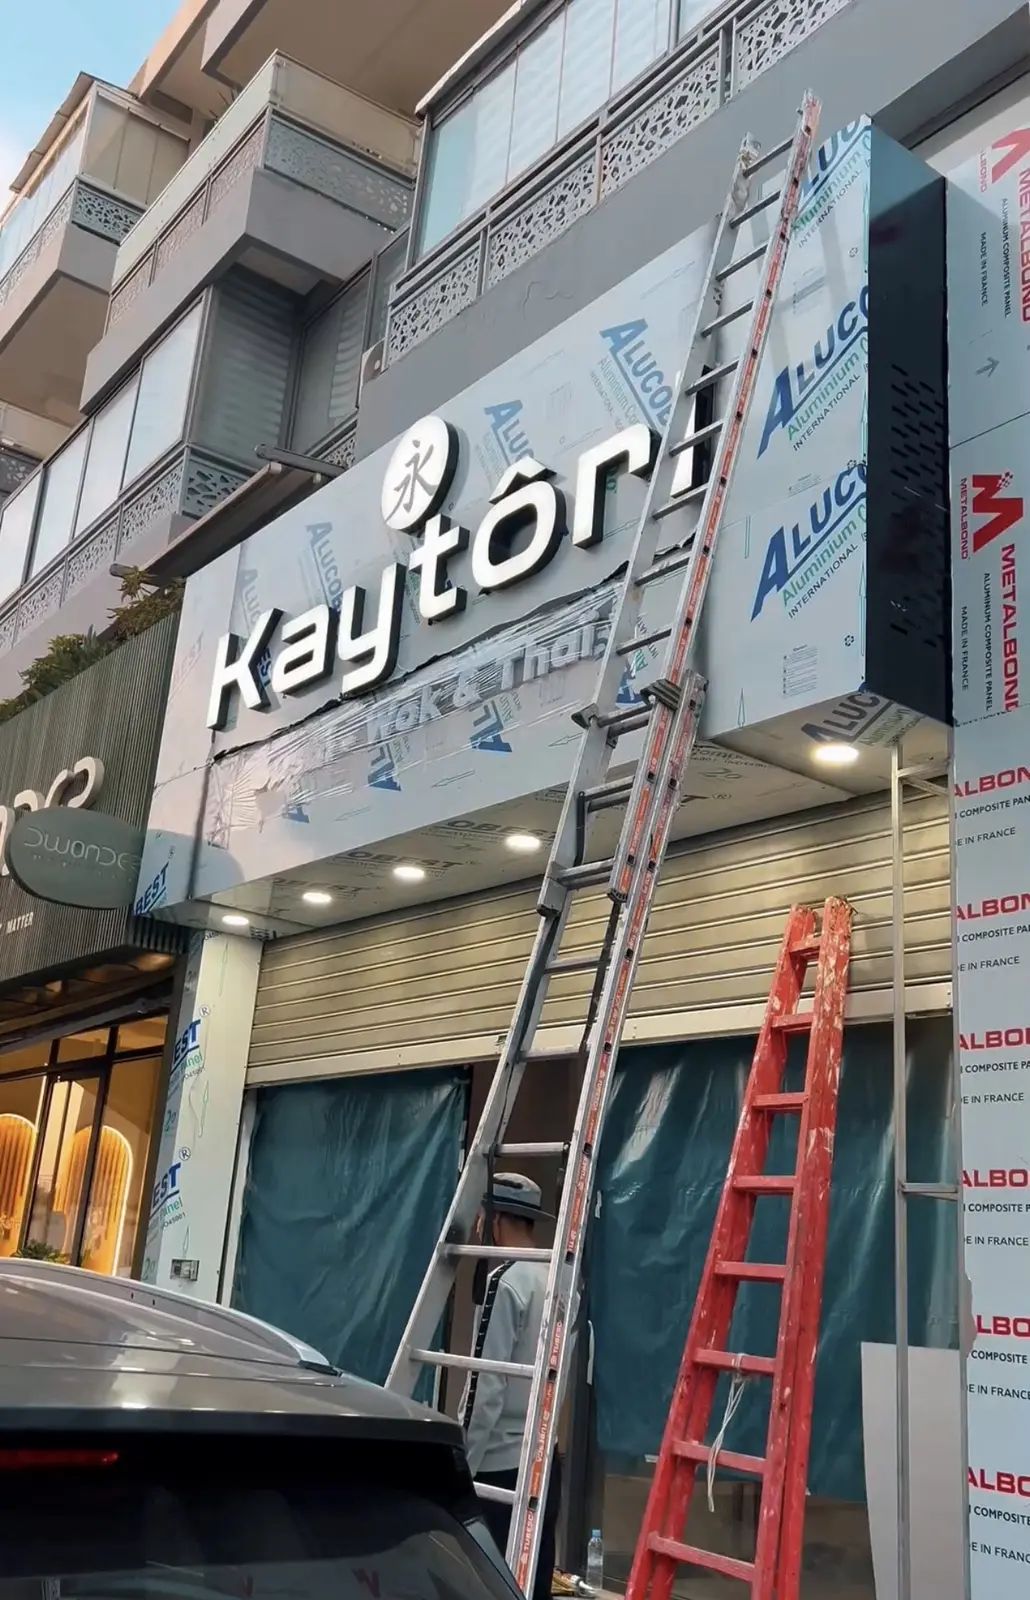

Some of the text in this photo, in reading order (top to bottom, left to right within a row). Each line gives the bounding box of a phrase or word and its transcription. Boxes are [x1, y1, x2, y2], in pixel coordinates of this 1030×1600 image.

[797, 169, 862, 248] INTERNATIONAL
[1002, 242, 1011, 290] COMPOSITE
[981, 270, 989, 307] FRANCE
[1004, 290, 1012, 319] PANEL
[787, 352, 861, 441] Aluminium
[793, 375, 861, 452] INTERNATIONAL
[385, 439, 439, 524] 永
[960, 477, 969, 560] METALBOND
[783, 520, 857, 607] Aluminium
[788, 543, 859, 619] INTERNATIONAL
[961, 638, 969, 649] IN
[984, 572, 993, 712] ALUMINUM COMPOSITE PANEL
[961, 650, 969, 692] FRANCE
[959, 800, 1010, 819] COMPOSITE
[965, 835, 974, 845] IN
[977, 826, 1016, 842] FRANCE
[962, 926, 1014, 942] COMPOSITE
[968, 955, 1020, 970] IN FRANCE
[965, 1061, 1019, 1074] COMPOSITE
[971, 1092, 1024, 1104] IN FRANCE
[968, 1202, 1023, 1213] COMPOSITE
[975, 1235, 1029, 1247] IN FRANCE
[971, 1349, 1028, 1365] COMPOSITE
[978, 1384, 988, 1395] IN
[980, 1543, 991, 1555] IN
